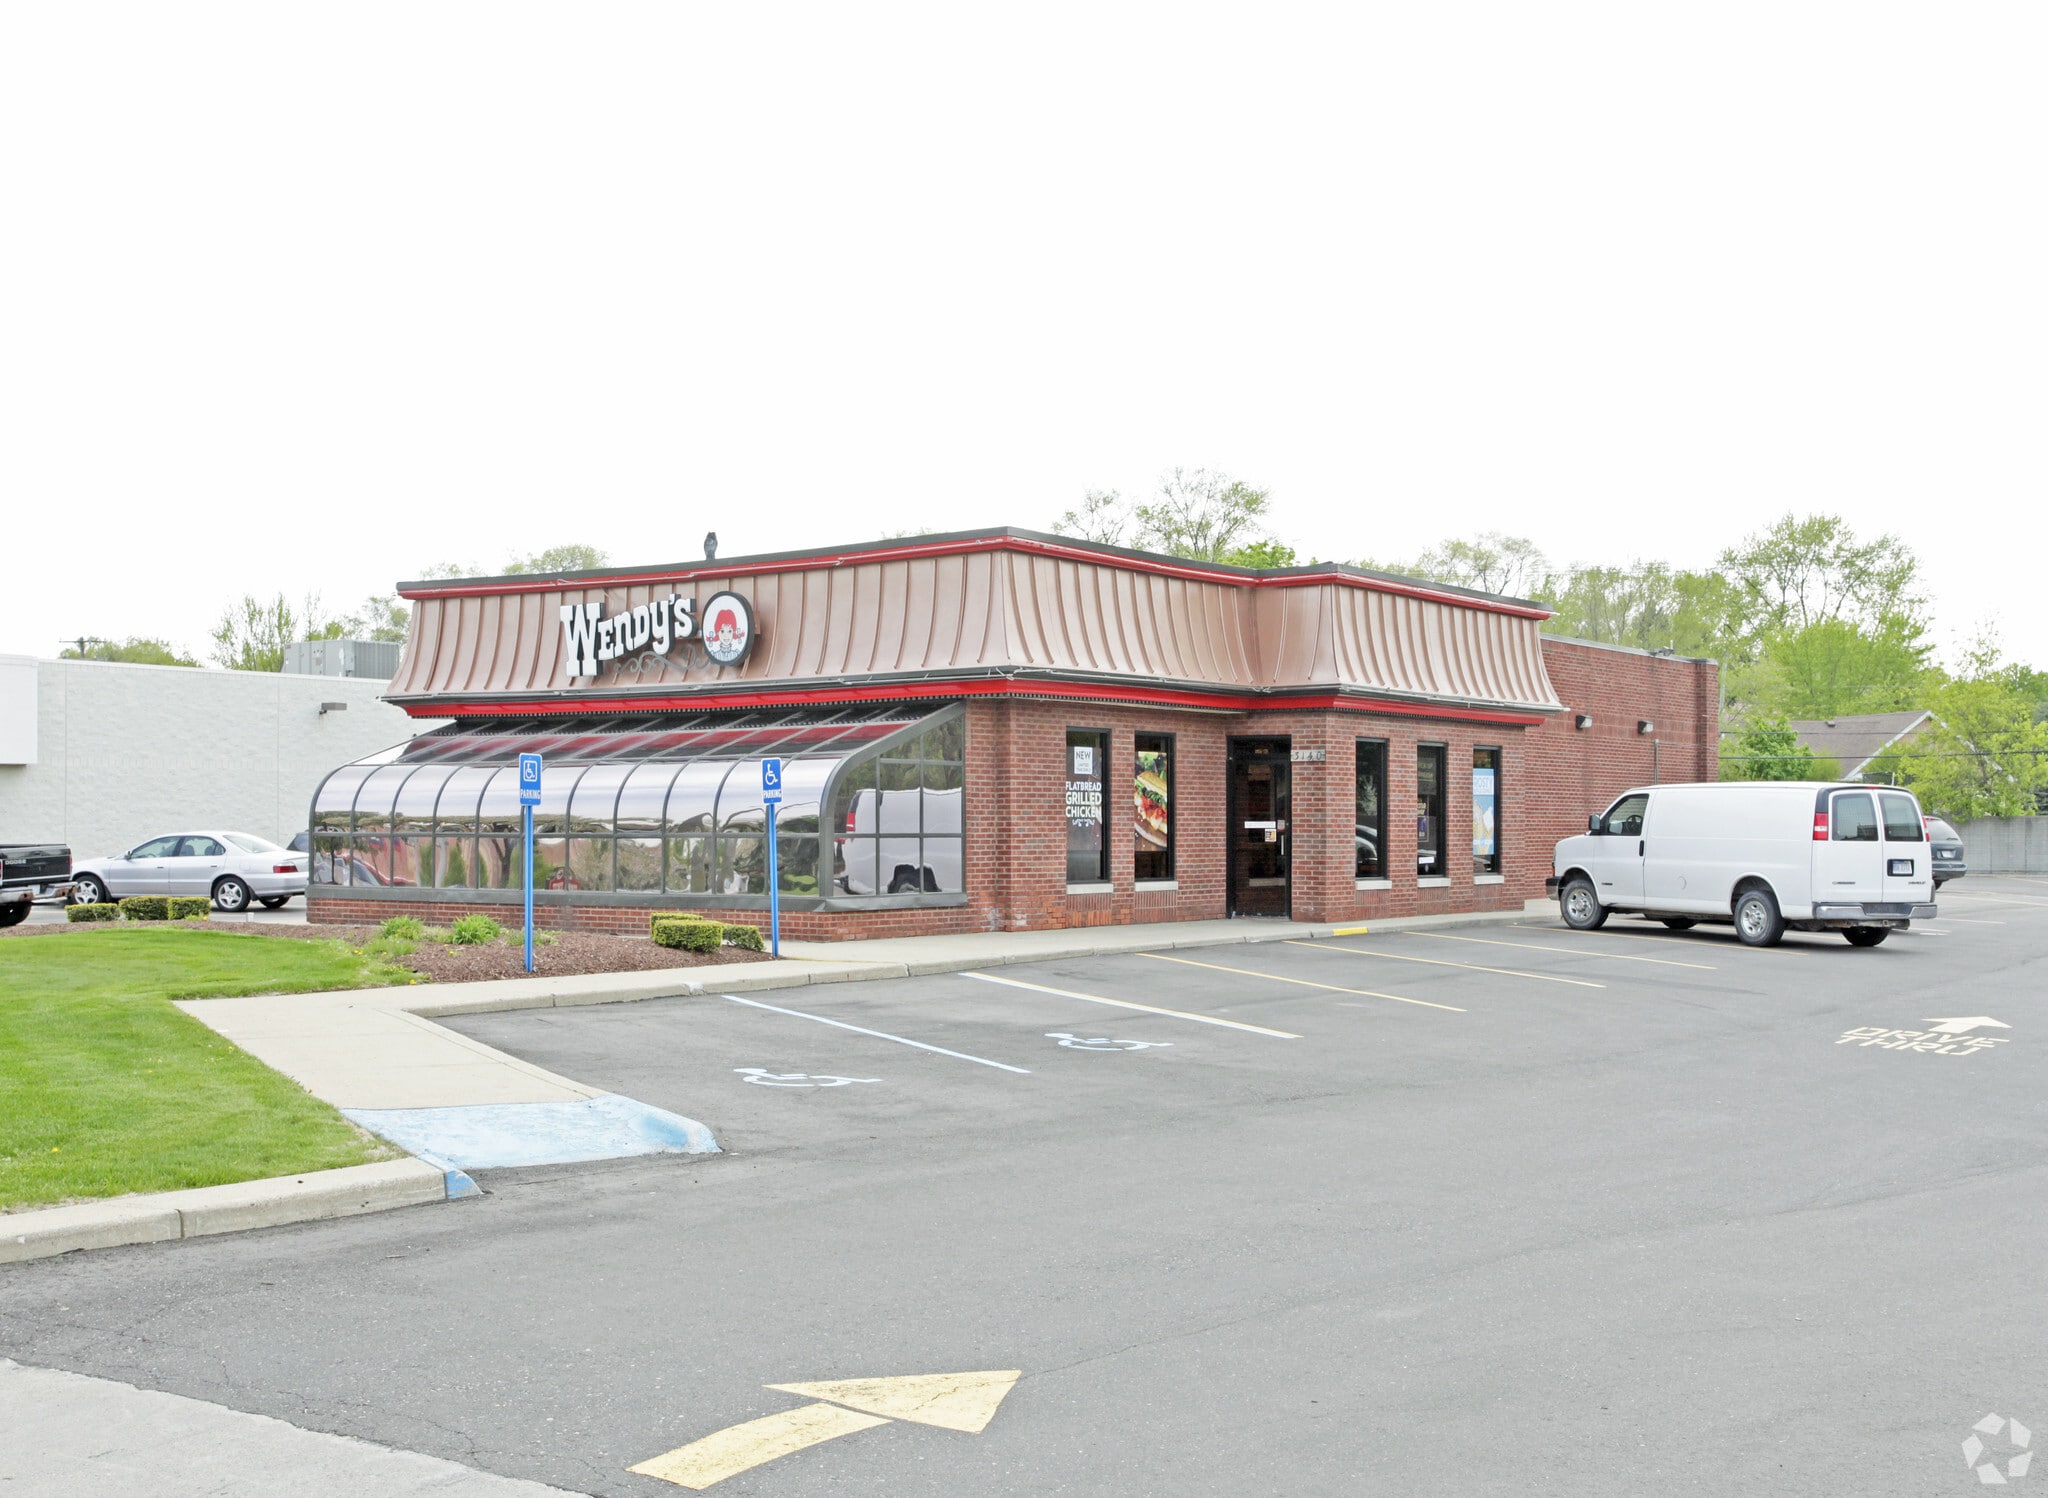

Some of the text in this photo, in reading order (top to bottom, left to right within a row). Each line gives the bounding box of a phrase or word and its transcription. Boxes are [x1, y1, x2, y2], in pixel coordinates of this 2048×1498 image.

[1075, 751, 1091, 760] NEW
[1065, 781, 1102, 791] FLATBREAD
[520, 789, 541, 799] PARKING
[763, 789, 783, 799] PARKING
[1065, 791, 1102, 806] GRILLED
[1065, 805, 1102, 818] CHICKEN
[1842, 1026, 2011, 1048] DRIVE
[1834, 1034, 1982, 1056] THRU
